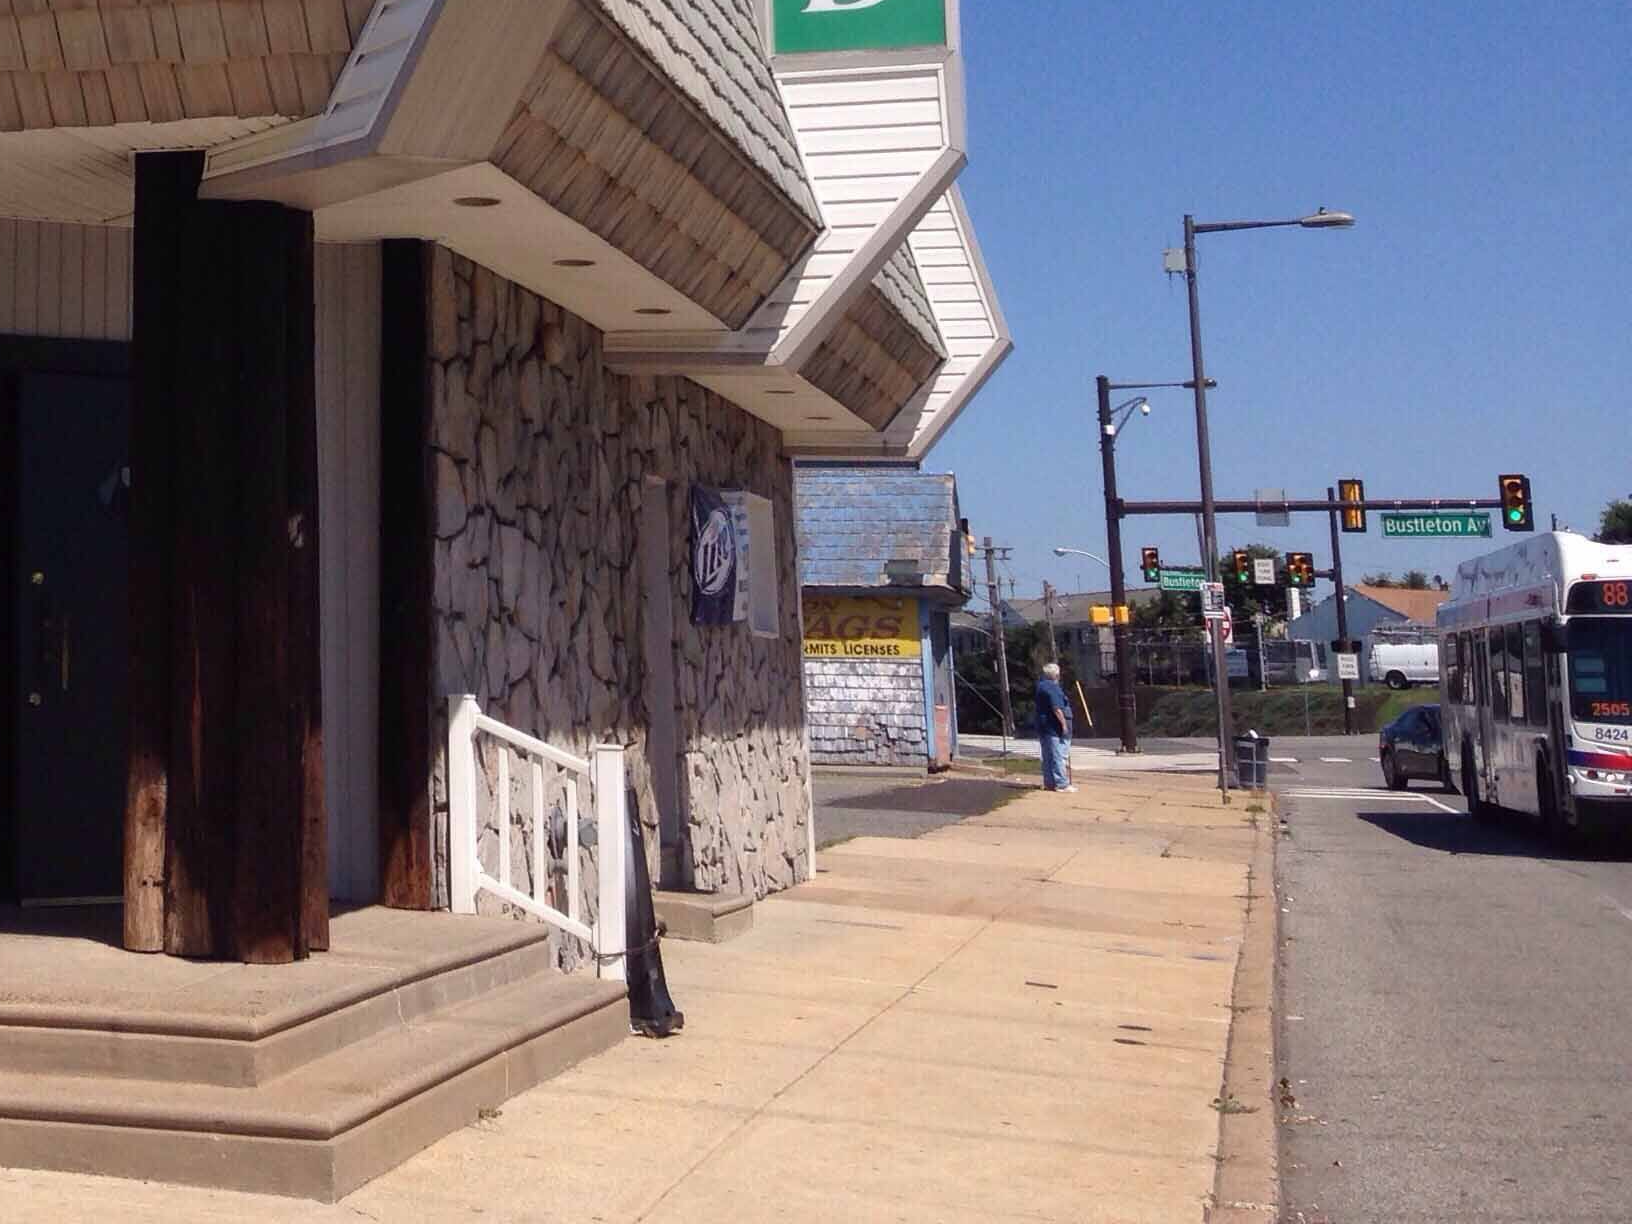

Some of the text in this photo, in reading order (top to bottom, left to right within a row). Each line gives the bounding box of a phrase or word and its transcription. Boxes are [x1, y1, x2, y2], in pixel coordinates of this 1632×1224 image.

[1386, 518, 1462, 533] Bustleton
[1603, 583, 1628, 605] 88
[802, 616, 903, 639] AGS
[843, 644, 901, 656] LICENSES
[1595, 727, 1628, 741] 8424
